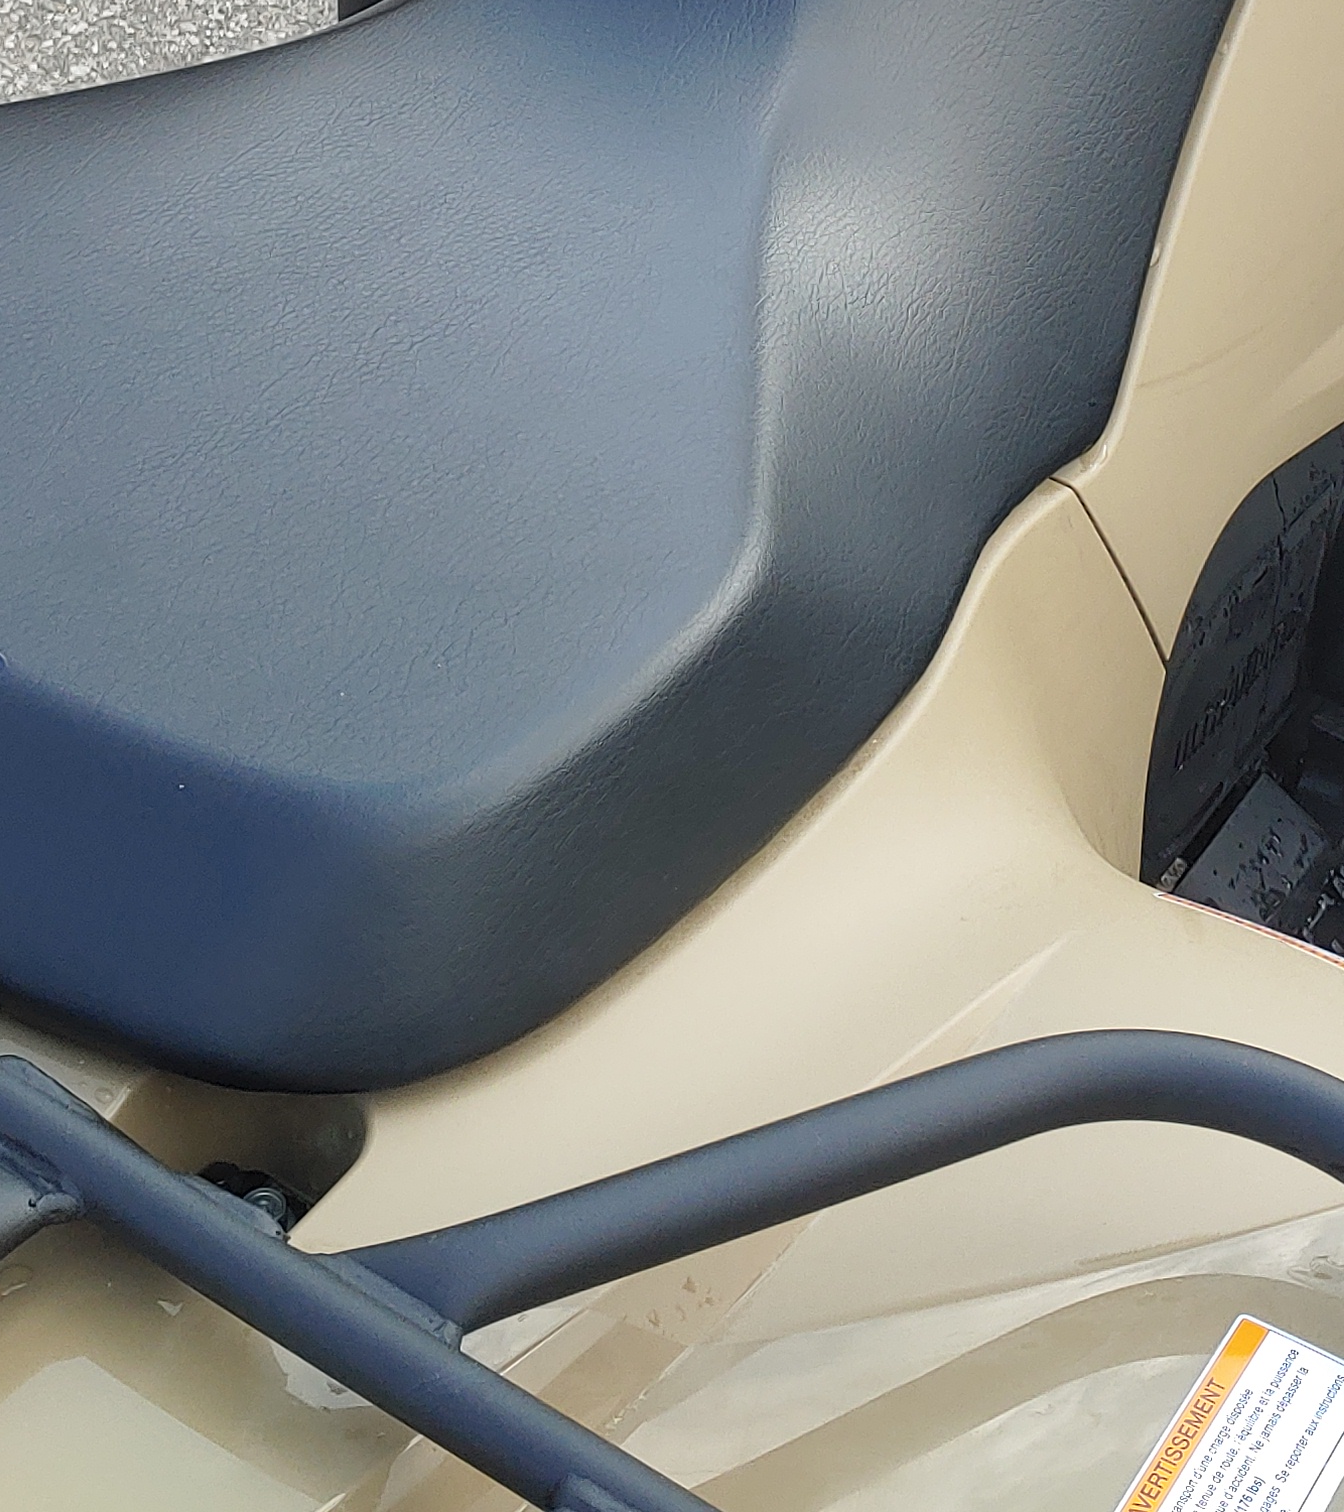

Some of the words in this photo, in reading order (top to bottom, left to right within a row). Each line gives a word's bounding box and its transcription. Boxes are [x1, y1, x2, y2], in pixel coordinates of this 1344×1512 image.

[1211, 1470, 1225, 1484] de
[1257, 1395, 1270, 1406] et
[1247, 1439, 1265, 1454] Ne
[1273, 1468, 1290, 1484] Se
[1284, 1434, 1309, 1470] reporter
[1303, 1417, 1320, 1437] aux
[1245, 1475, 1266, 1496] lbs)
